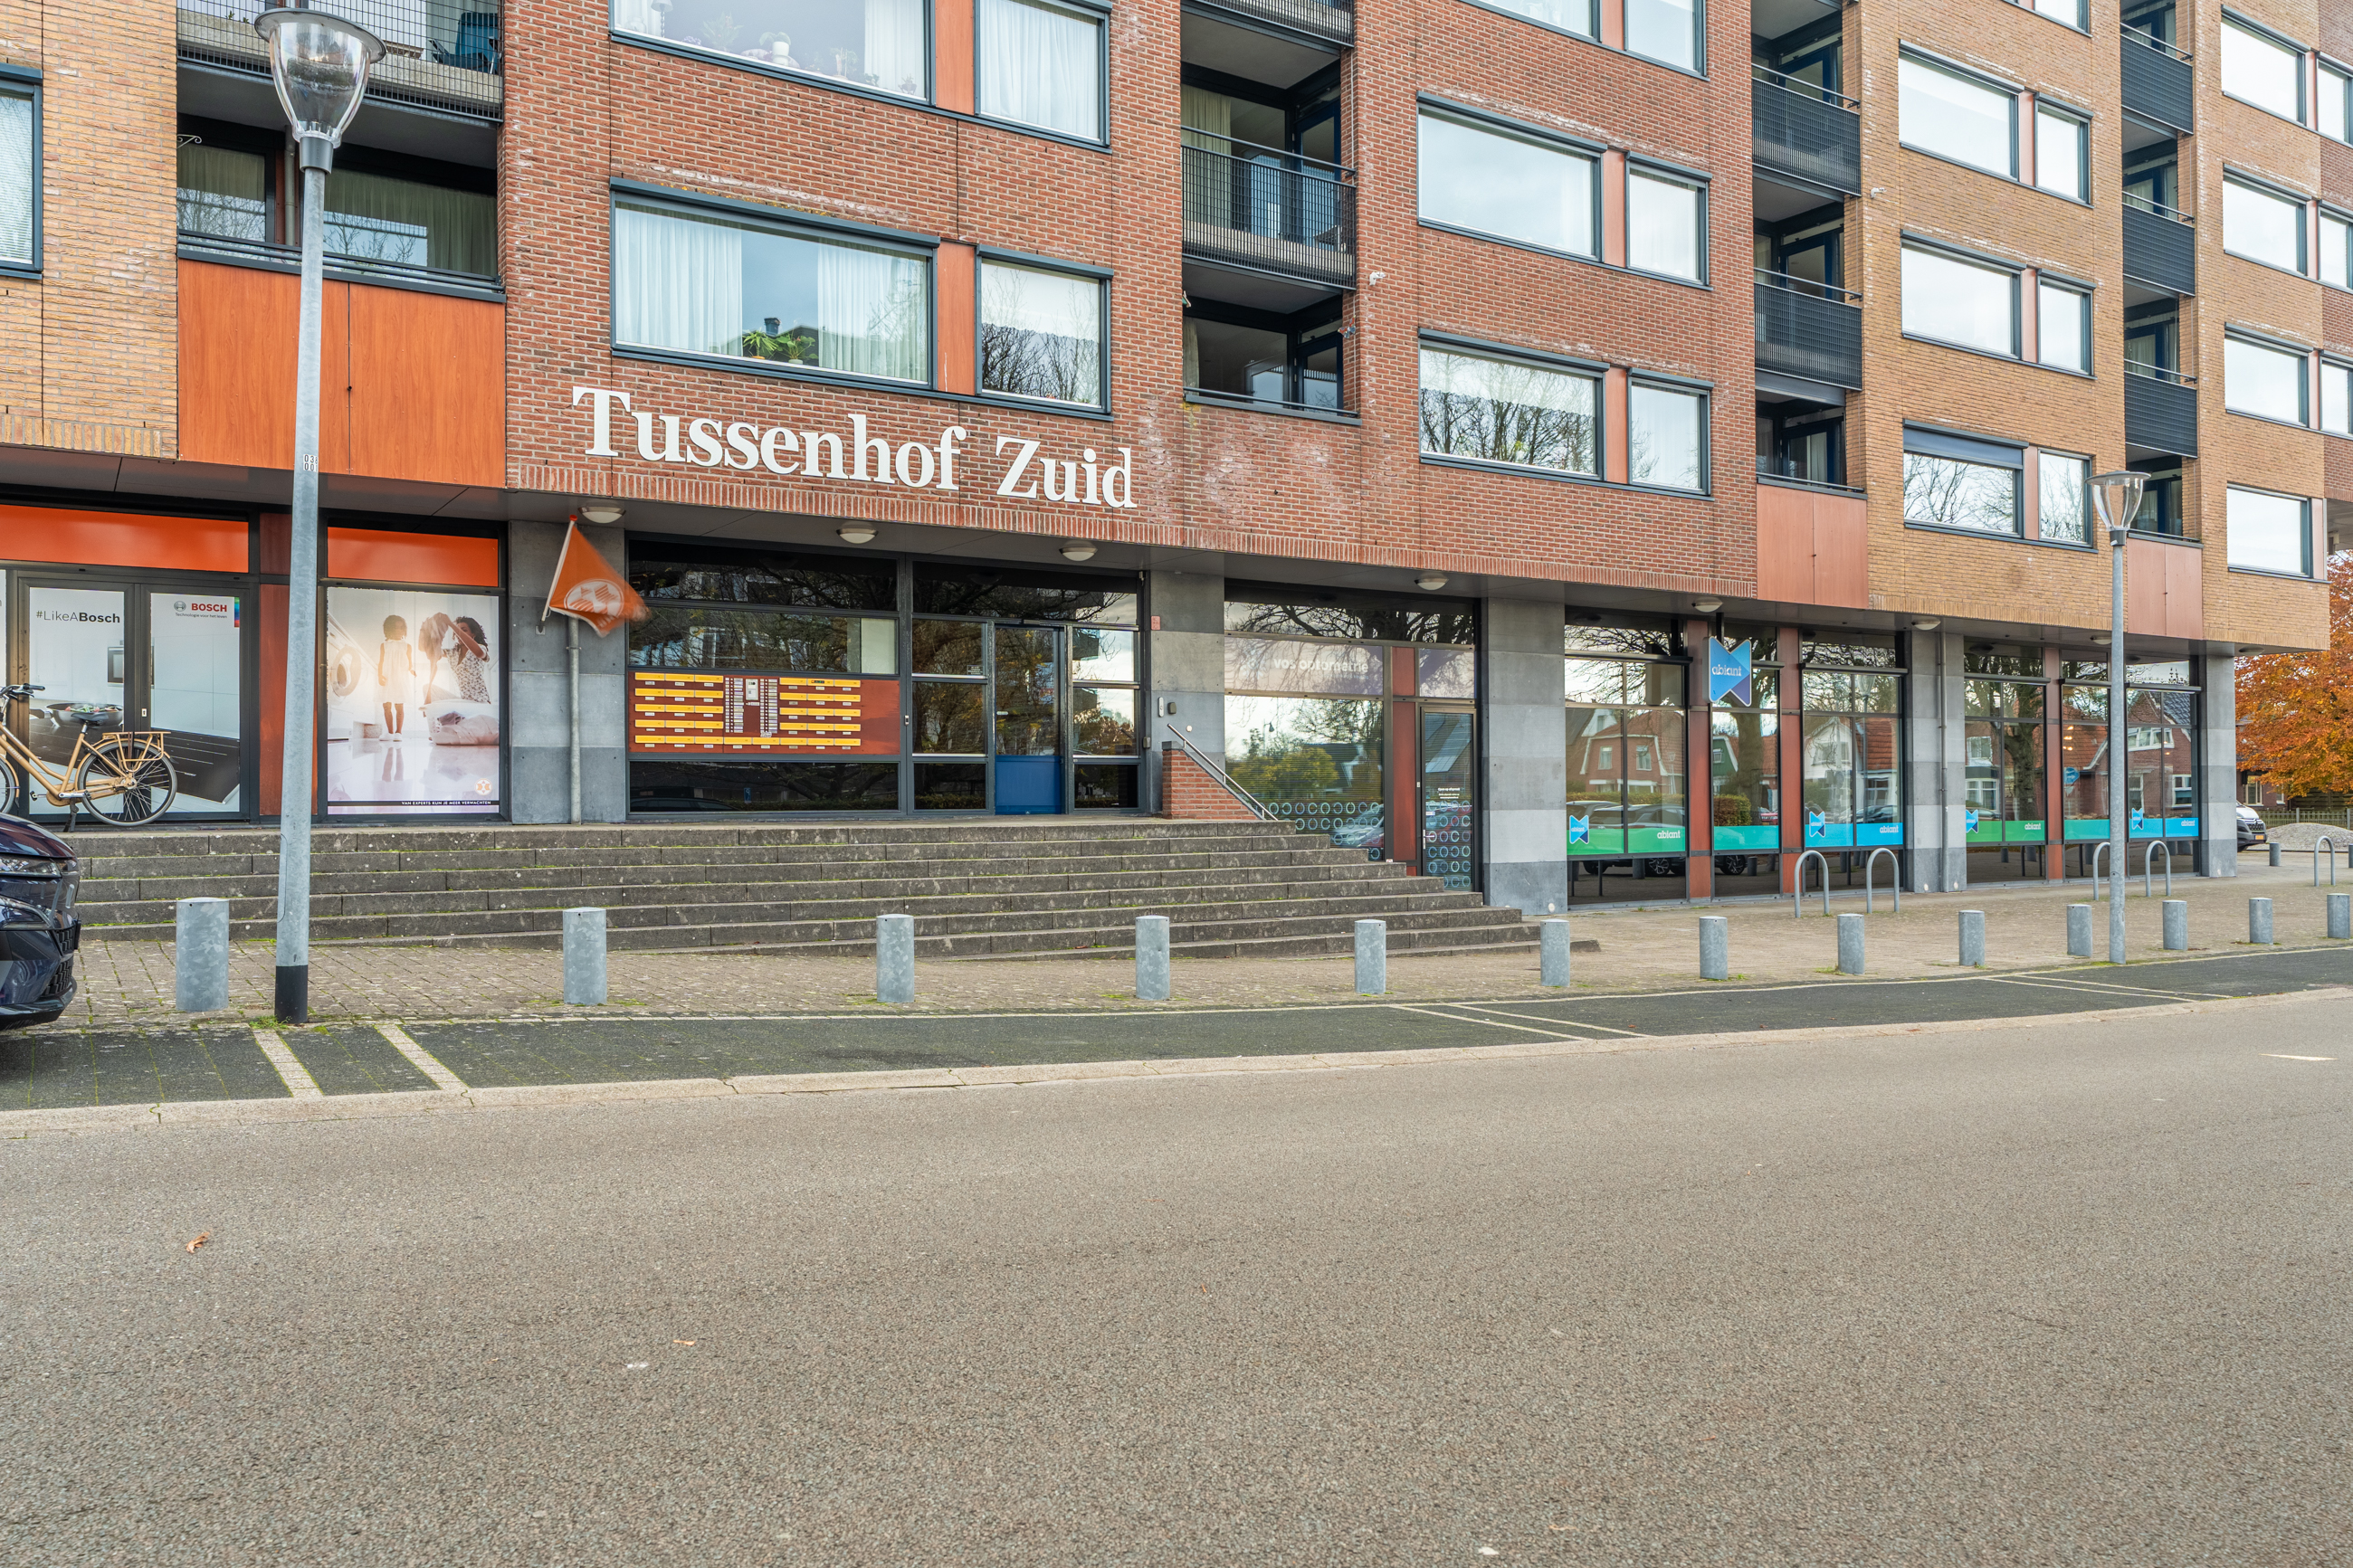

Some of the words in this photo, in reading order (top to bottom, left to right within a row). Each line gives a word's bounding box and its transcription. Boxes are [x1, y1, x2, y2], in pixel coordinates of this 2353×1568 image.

[572, 386, 967, 490] Tussenhof
[996, 435, 1137, 508] Zuid
[191, 603, 227, 613] BOSCH
[36, 610, 120, 624] #LikeABosch
[1273, 658, 1296, 670] vos
[1299, 659, 1368, 673] optometrie
[1711, 664, 1742, 677] abiant
[1657, 830, 1681, 839] abiant
[1879, 824, 1900, 833] abiant
